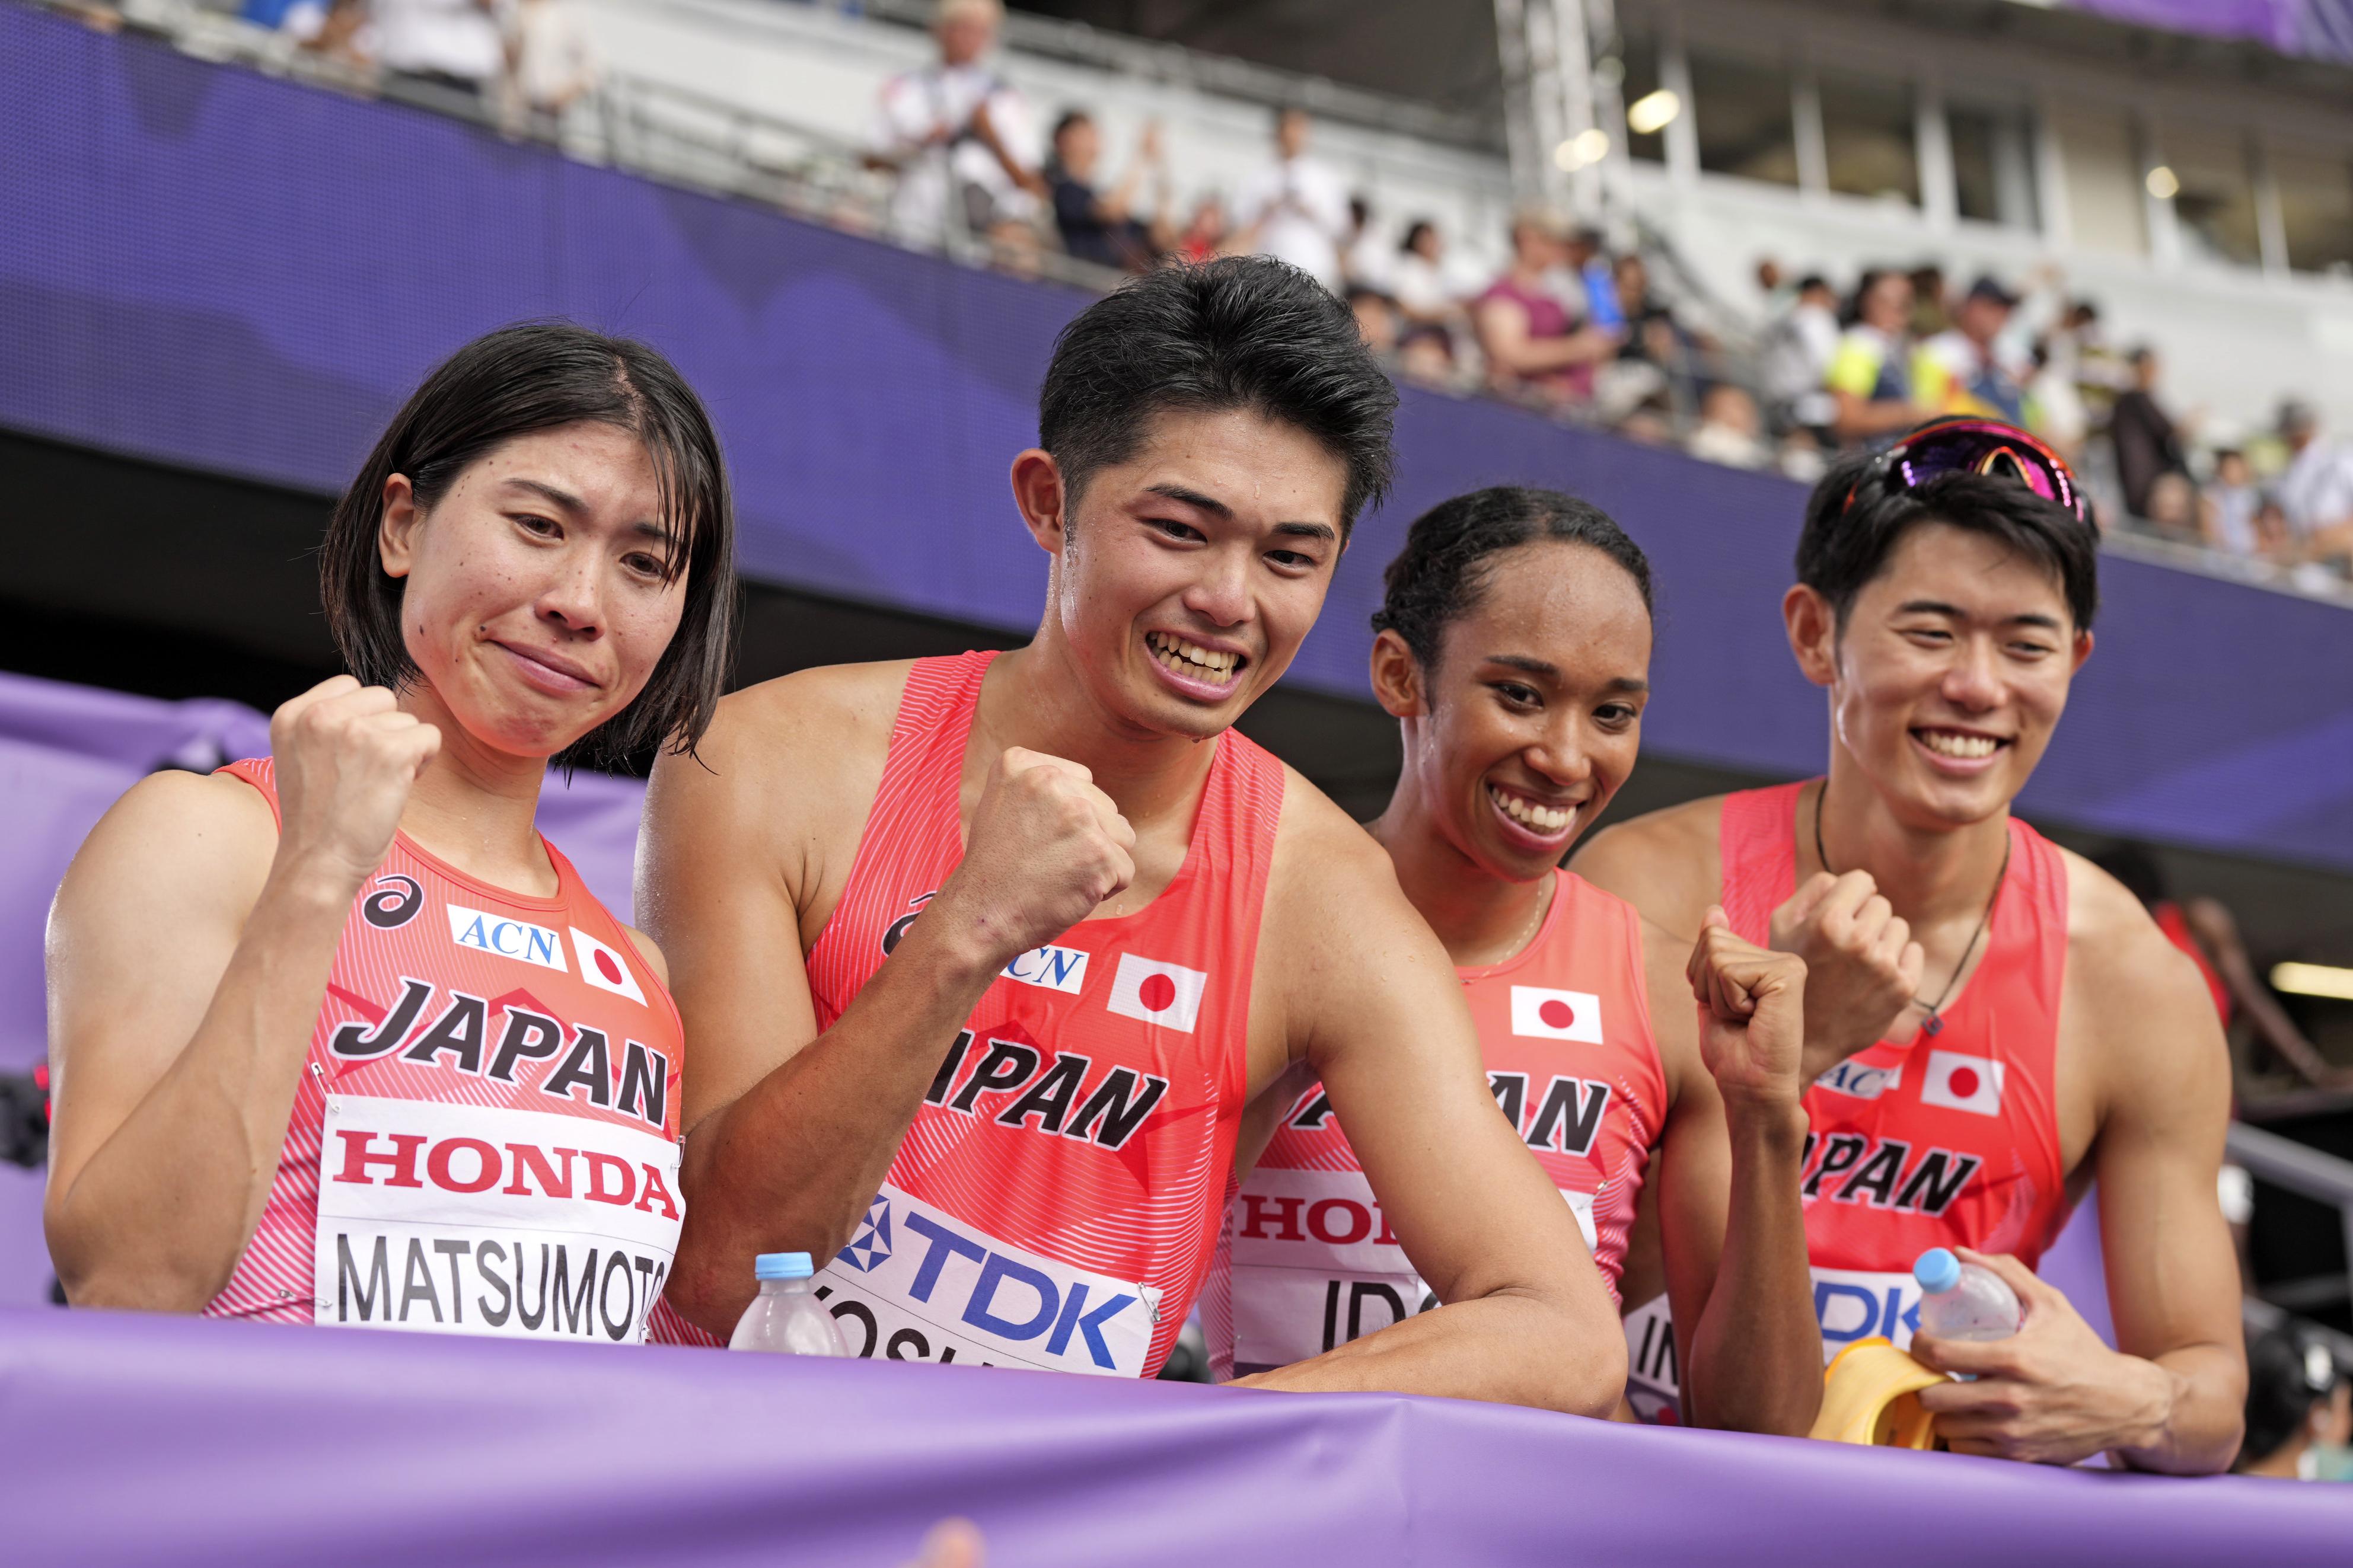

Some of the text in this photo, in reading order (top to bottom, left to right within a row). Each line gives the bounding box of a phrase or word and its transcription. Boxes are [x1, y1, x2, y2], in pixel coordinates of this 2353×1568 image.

[461, 915, 556, 965] ACN
[329, 976, 667, 1130] JAPAN
[333, 1129, 679, 1221] HONDA
[336, 1233, 665, 1344] MATSUMOTO
[904, 1211, 1137, 1370] TDK
